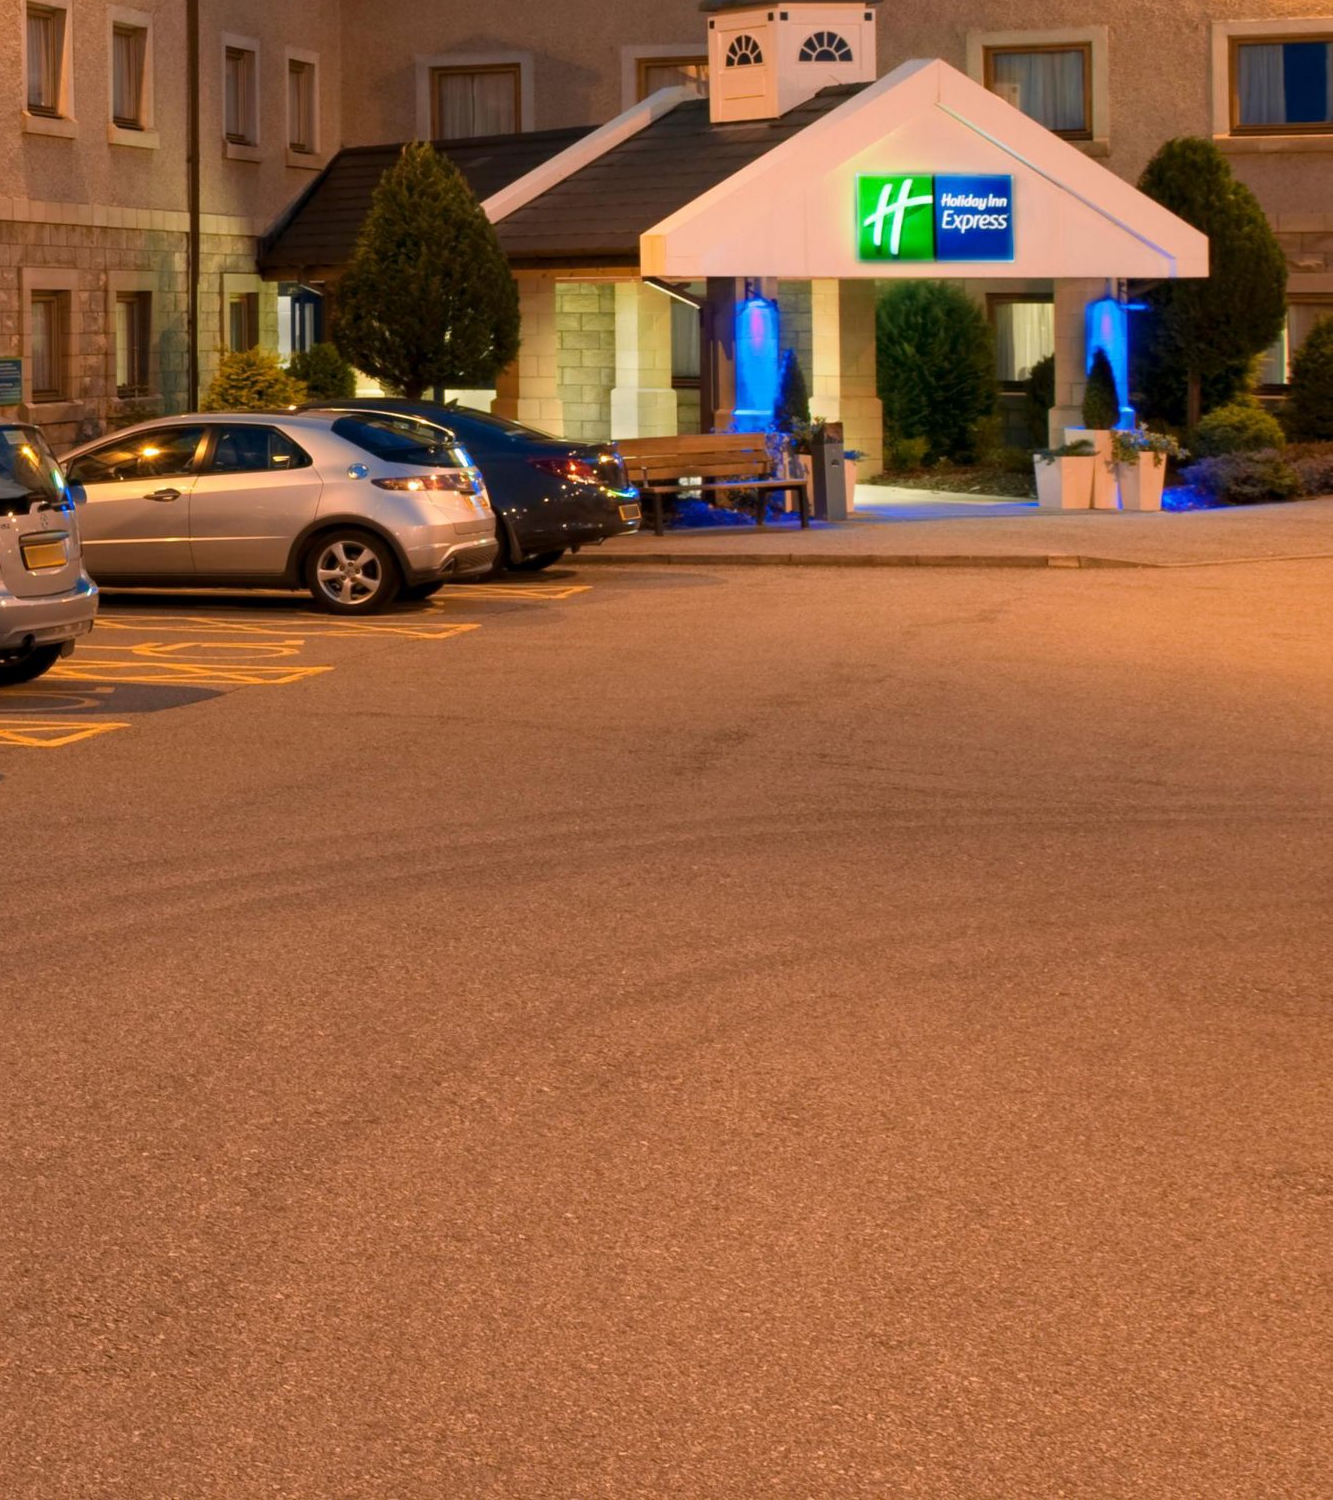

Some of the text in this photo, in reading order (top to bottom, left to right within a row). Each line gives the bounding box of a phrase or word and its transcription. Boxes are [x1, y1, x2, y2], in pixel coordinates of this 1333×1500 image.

[940, 192, 1008, 211] Holiday Inn
[941, 209, 1008, 234] Express
